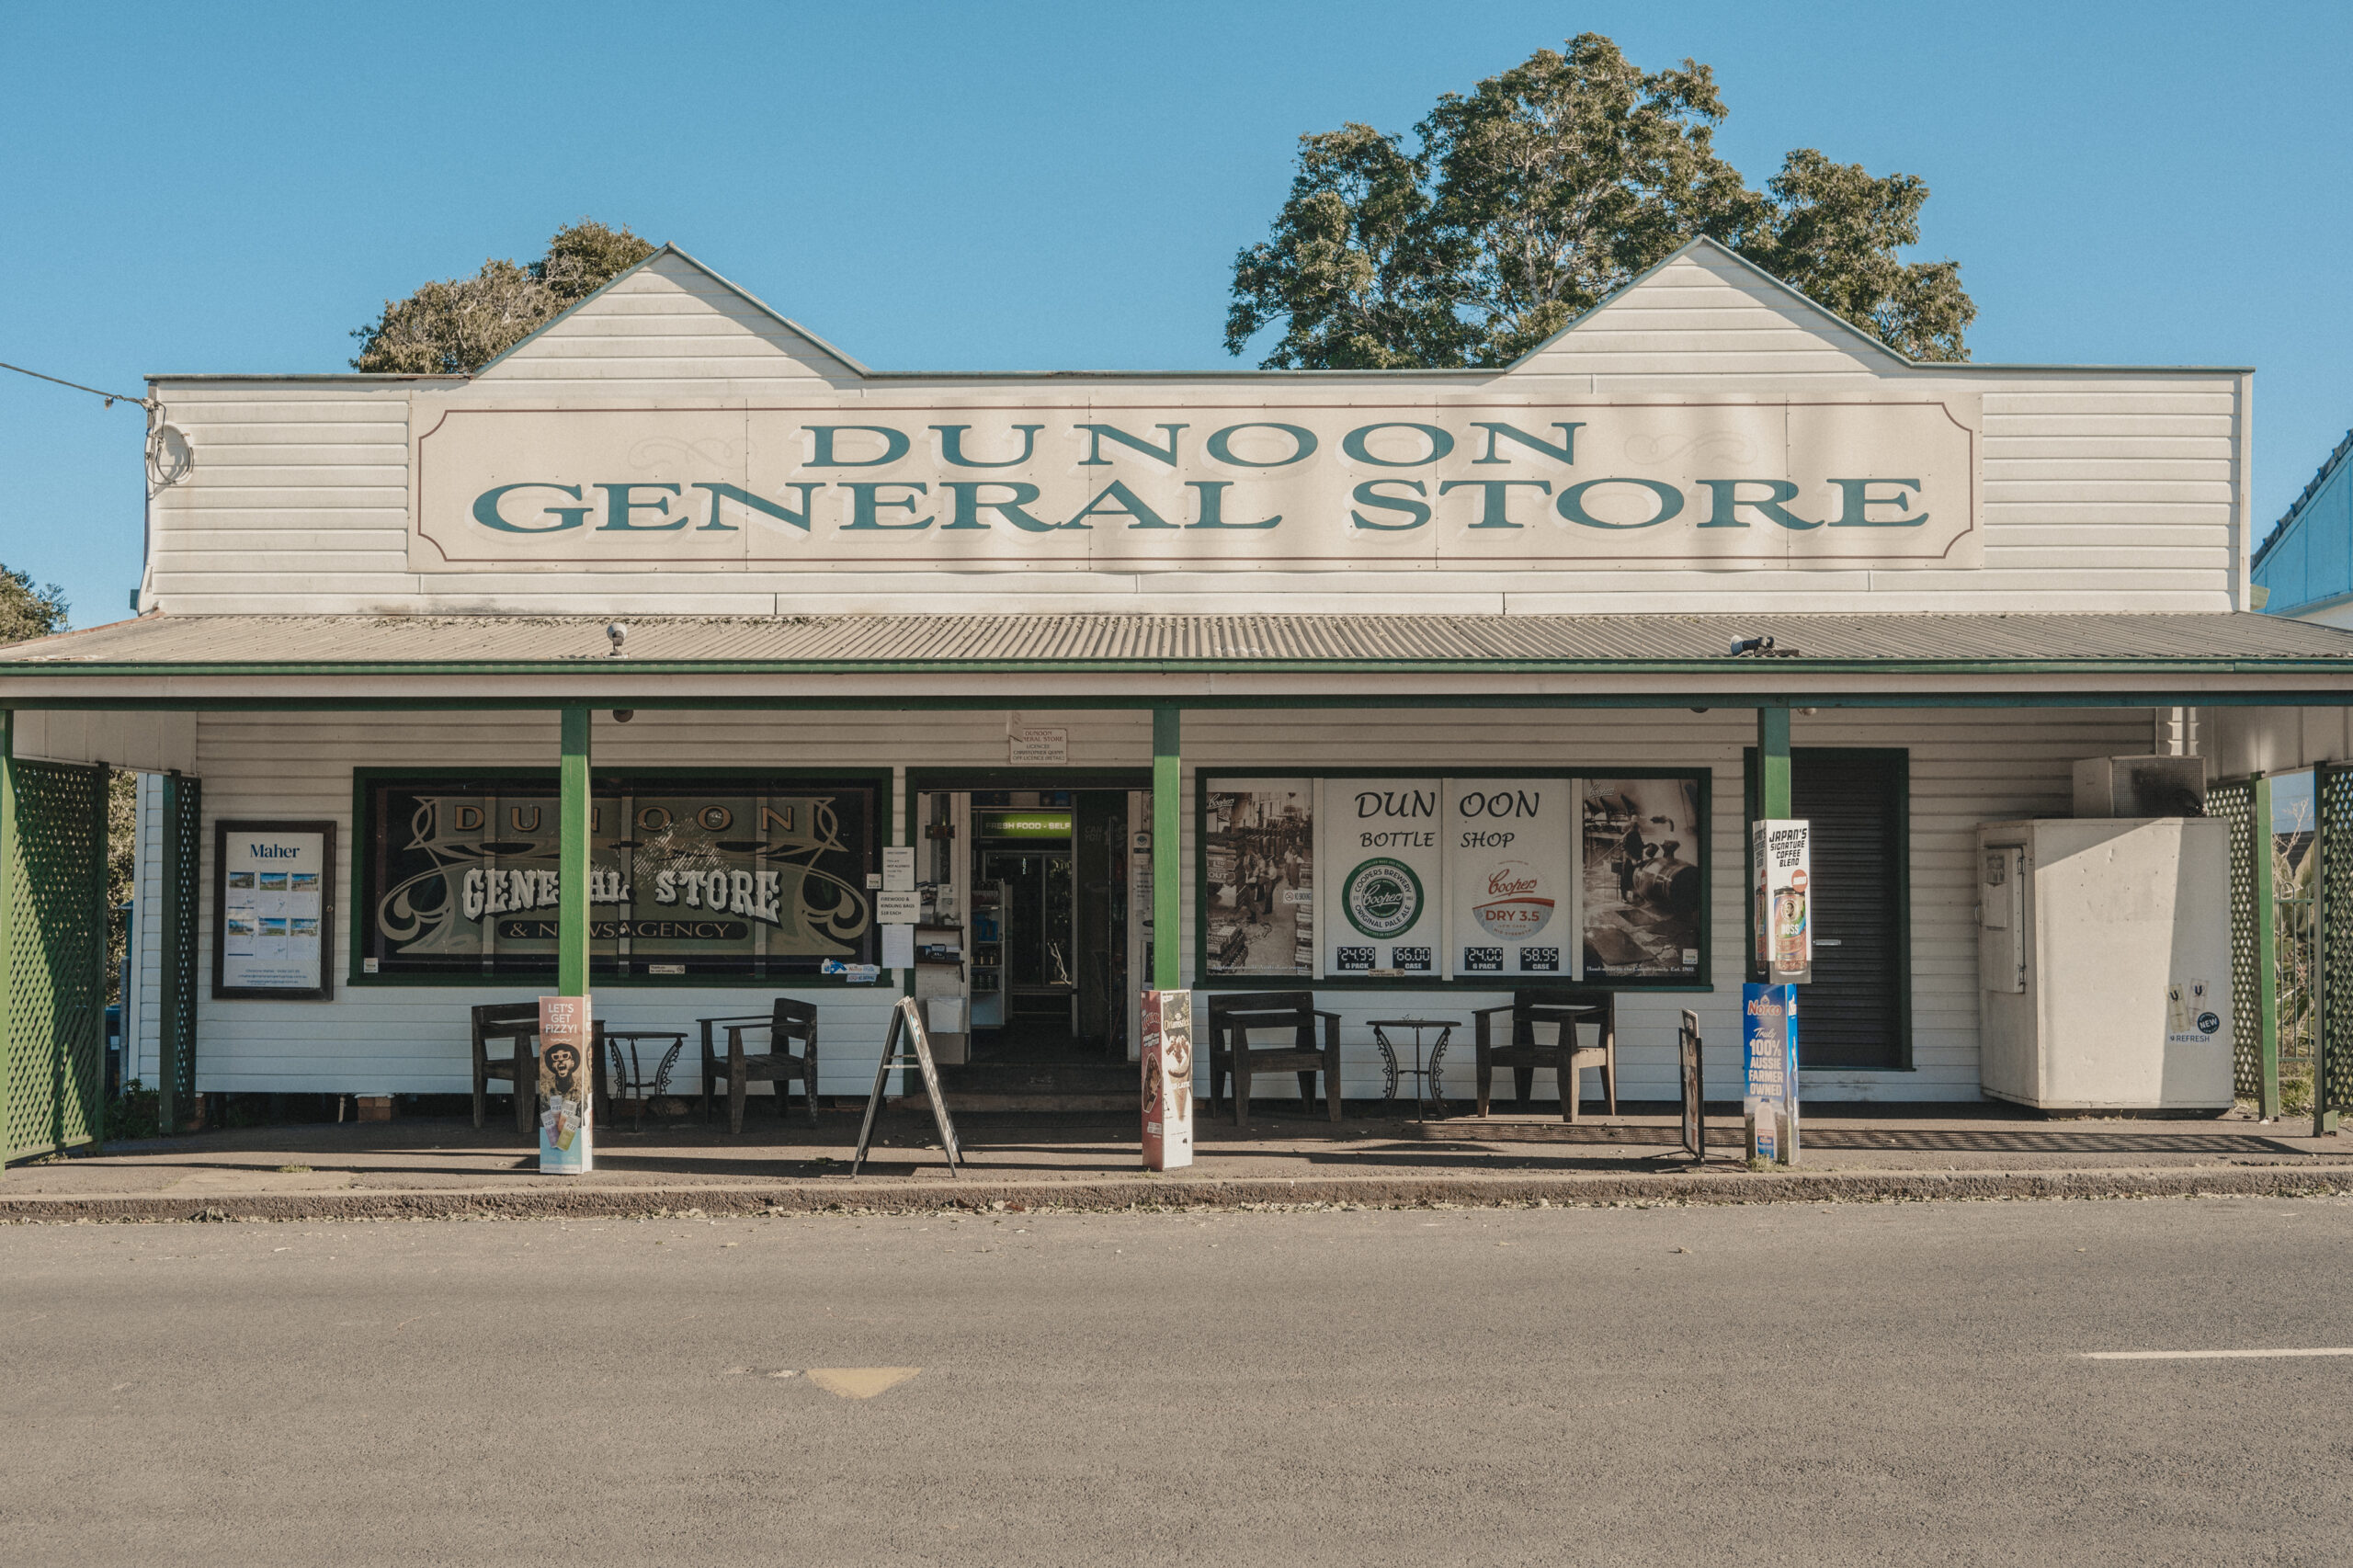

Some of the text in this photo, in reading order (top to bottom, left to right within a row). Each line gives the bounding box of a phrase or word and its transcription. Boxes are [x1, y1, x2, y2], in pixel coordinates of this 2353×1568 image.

[800, 422, 1587, 470] DUNOON
[472, 476, 1930, 535] GENERAL STORE
[454, 804, 793, 832] DUOON
[985, 822, 1015, 830] FRESH
[1016, 822, 1041, 830] FOOD
[1048, 822, 1072, 830] SELF
[1359, 831, 1515, 848] BOTTLE SHOP
[1768, 827, 1808, 843] JAPAN'S
[249, 843, 301, 858] Maher
[1769, 839, 1805, 851] SIGNATURE
[1776, 848, 1802, 859] COFFEE
[1779, 858, 1800, 868] BLEND
[1354, 868, 1413, 893] COOPERS BREWERY
[1488, 869, 1538, 898] Coopers
[461, 868, 780, 923] GENEAL STORE
[1361, 883, 1403, 909] Coopers
[1355, 904, 1383, 928] ORIGINAL
[1384, 915, 1403, 928] PALE
[1402, 904, 1413, 919] ALE
[1485, 910, 1540, 922] DRY 3.5
[509, 922, 529, 937] &
[1392, 948, 1430, 961] $66.00
[548, 1003, 574, 1014] LET'S
[1747, 999, 1782, 1017] Norco
[551, 1014, 572, 1023] GET
[2199, 1017, 2218, 1029] NEW
[545, 1023, 578, 1034] FIZZY!
[1753, 1027, 1778, 1039] Truly
[1749, 1039, 1781, 1057] 100%
[1749, 1056, 1782, 1070] AUSSIE
[1748, 1069, 1784, 1084] FARMER
[1749, 1083, 1782, 1096] OWNED
